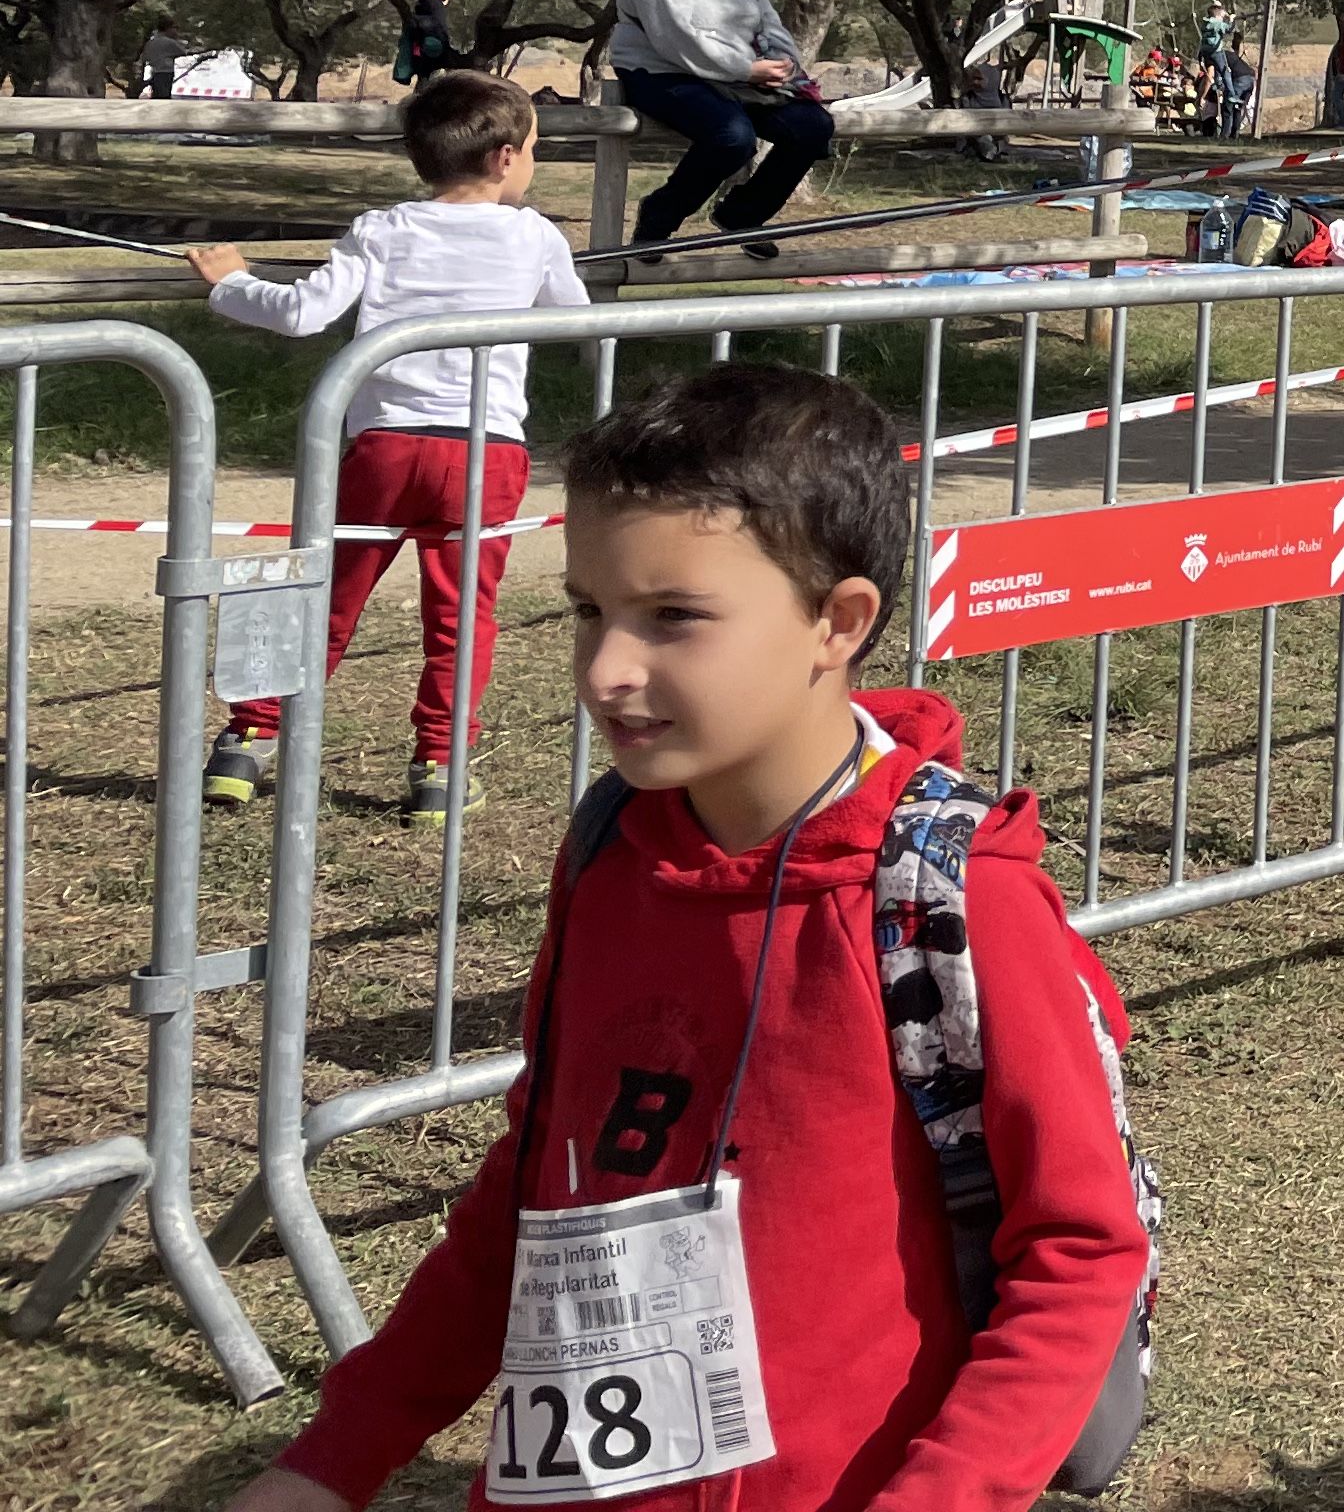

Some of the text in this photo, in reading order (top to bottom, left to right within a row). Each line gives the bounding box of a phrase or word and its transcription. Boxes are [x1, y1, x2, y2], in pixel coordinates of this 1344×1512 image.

[1215, 536, 1323, 568] Ajuntament de Rubí
[969, 572, 1043, 596] DISCULPEU
[1089, 579, 1152, 599] www.rubi.cat
[968, 588, 1071, 617] LES MOLÈSTIES!
[592, 1065, 694, 1177] B
[563, 1237, 627, 1265] Infantil
[531, 1268, 619, 1301] Regularitat
[560, 1337, 620, 1361] PERNAS
[499, 1375, 652, 1479] 128
